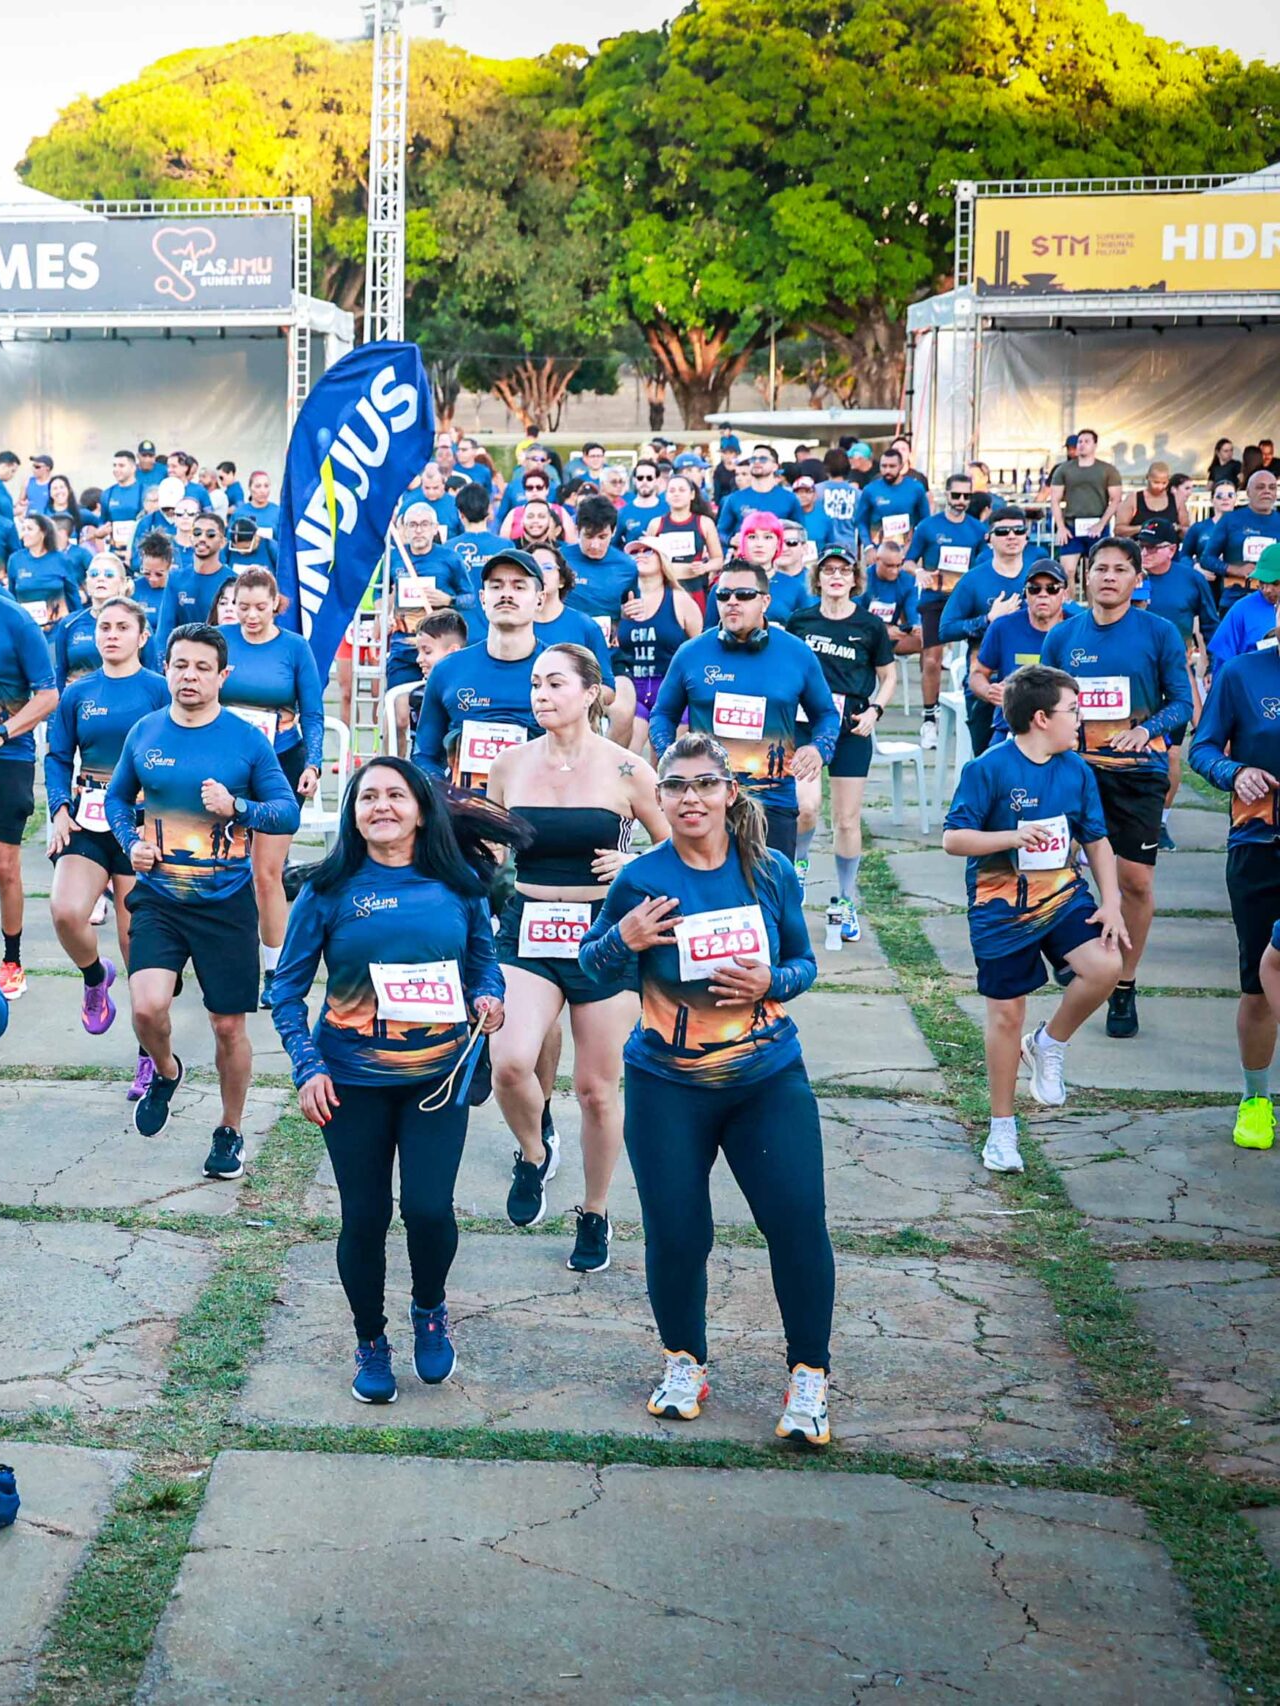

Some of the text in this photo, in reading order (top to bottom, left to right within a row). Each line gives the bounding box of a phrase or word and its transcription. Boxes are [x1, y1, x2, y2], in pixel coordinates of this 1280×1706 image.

[1031, 235, 1089, 256] STM
[200, 275, 271, 287] SUNSET RUN
[300, 366, 418, 642] INDJUS
[1082, 692, 1118, 706] 5118
[531, 924, 586, 941] 5309
[693, 932, 755, 957] 5249
[389, 984, 450, 1001] 5248
